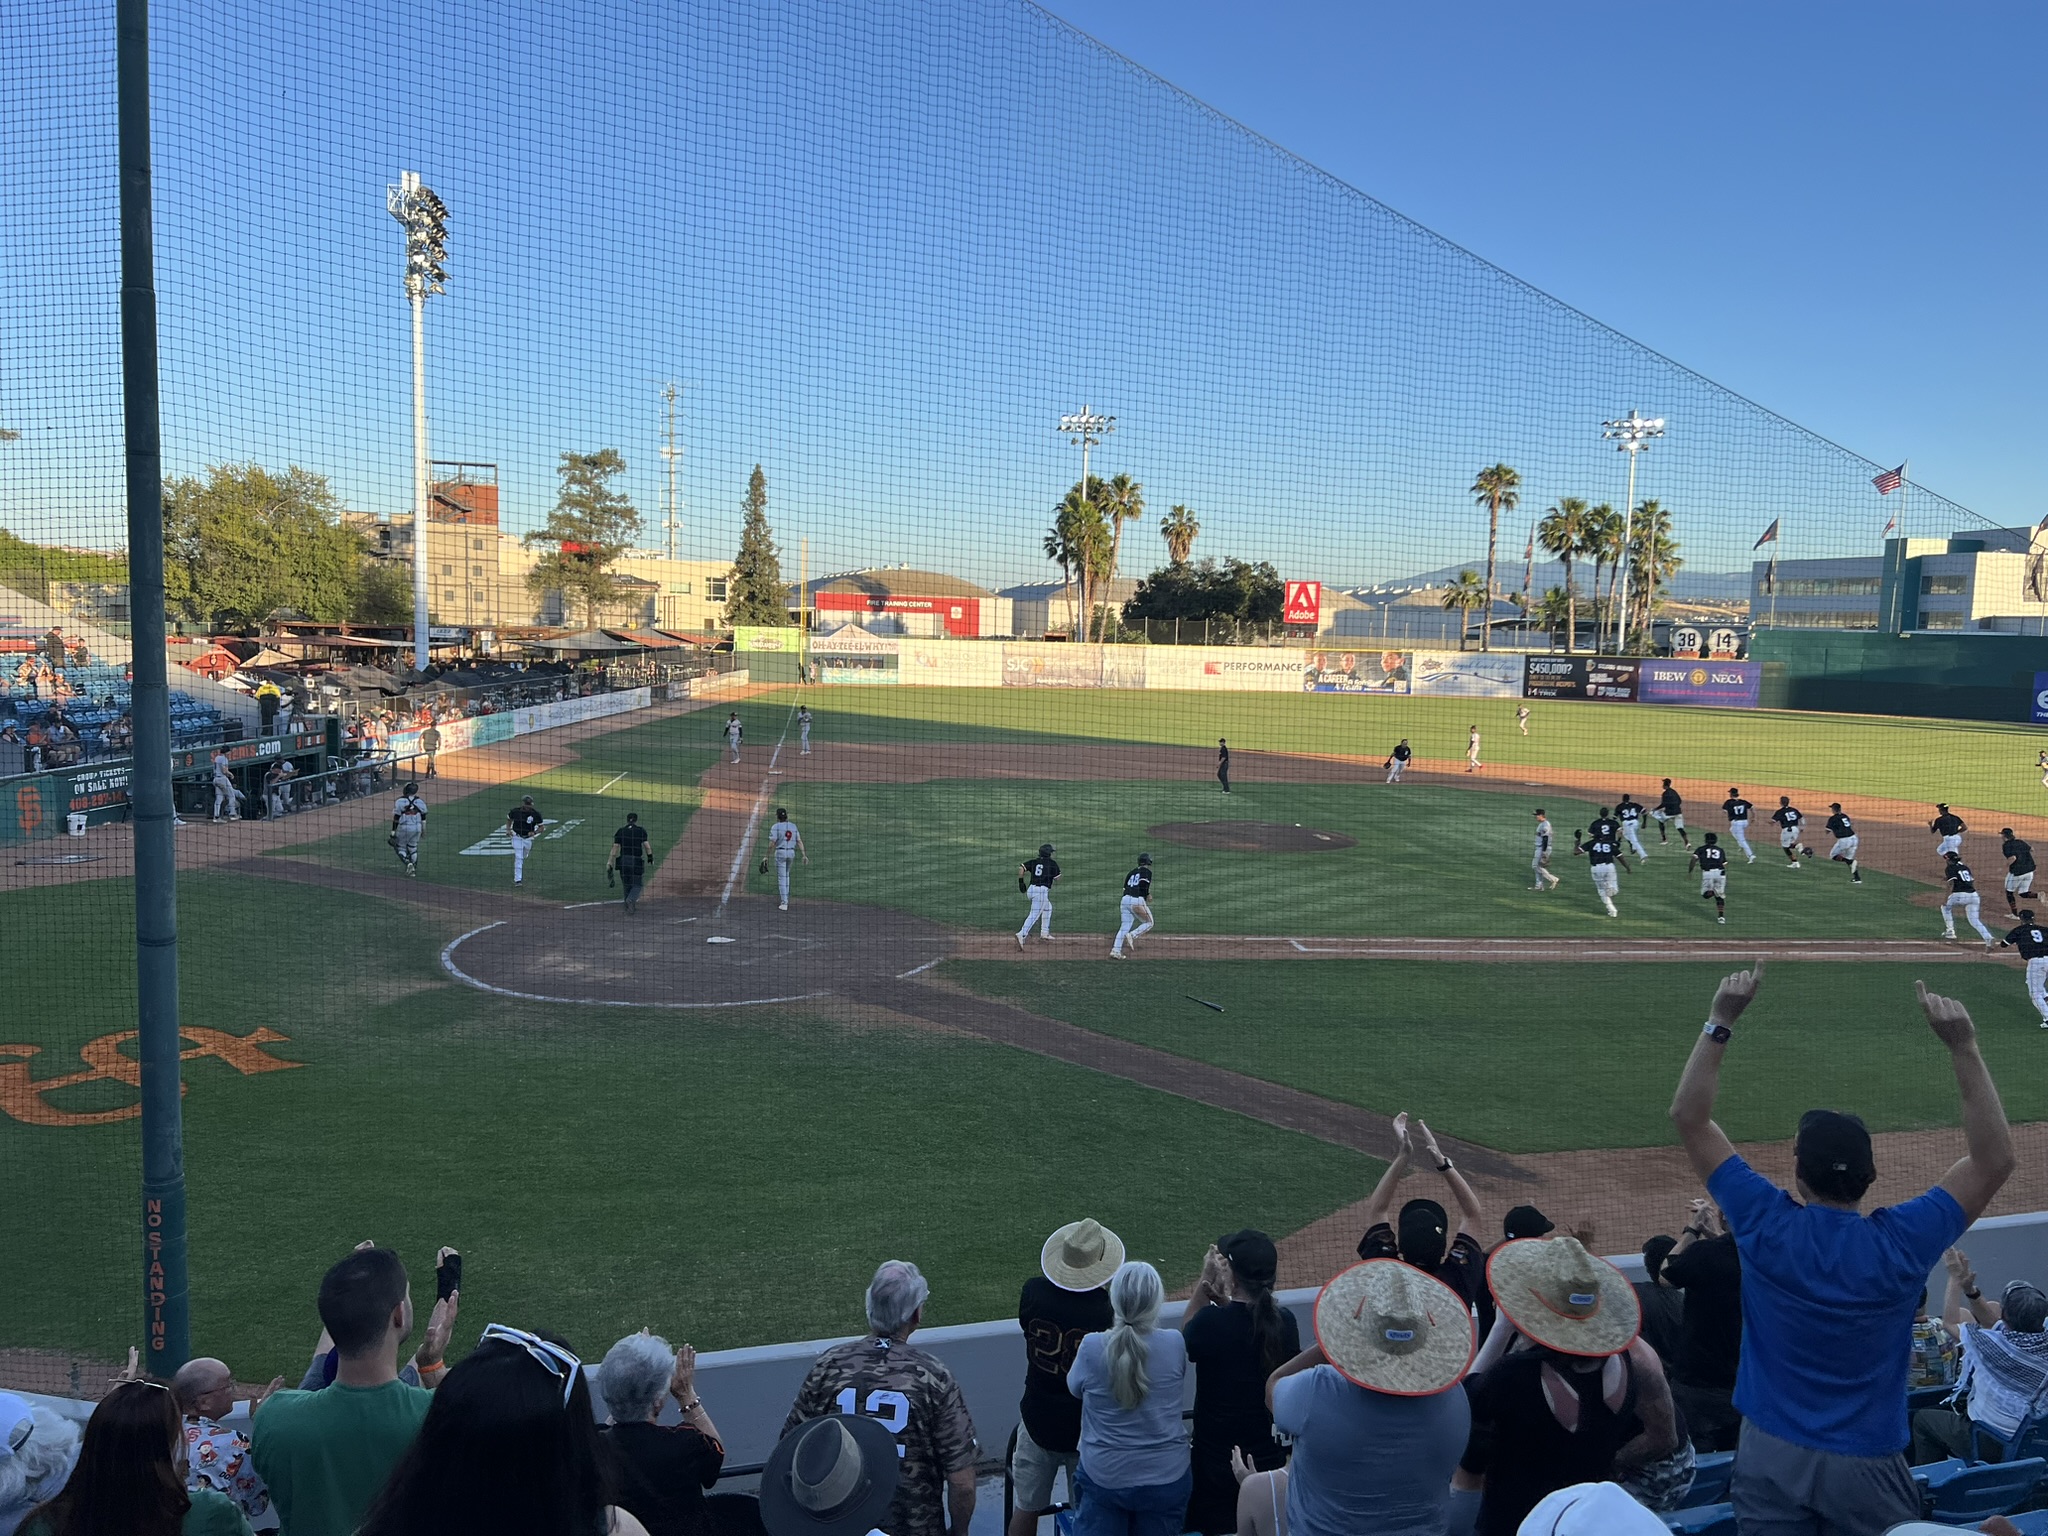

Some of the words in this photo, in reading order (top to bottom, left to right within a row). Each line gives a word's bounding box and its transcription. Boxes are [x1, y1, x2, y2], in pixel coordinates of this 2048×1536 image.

[1288, 610, 1316, 620] Adobe
[1678, 632, 1696, 647] 38
[1716, 632, 1731, 648] 14
[1006, 658, 1029, 672] SJC
[1223, 662, 1302, 672] PERFORMANCE
[1653, 671, 1687, 682] IBEW
[1711, 673, 1744, 685] NECA
[77, 772, 98, 782] GROUP
[100, 767, 125, 778] TICKETS
[74, 783, 85, 795] ON
[88, 780, 107, 793] SALE
[1621, 807, 1637, 818] 34
[1733, 805, 1745, 815] 17
[1784, 811, 1797, 822] 15
[1841, 817, 1851, 828] 5
[1601, 824, 1610, 835] 2
[1706, 848, 1721, 859] 13
[1034, 864, 1044, 877] 6
[1957, 869, 1971, 882] 16
[2030, 929, 2043, 943] 9
[147, 1199, 162, 1228] NO
[148, 1230, 166, 1351] STANDING
